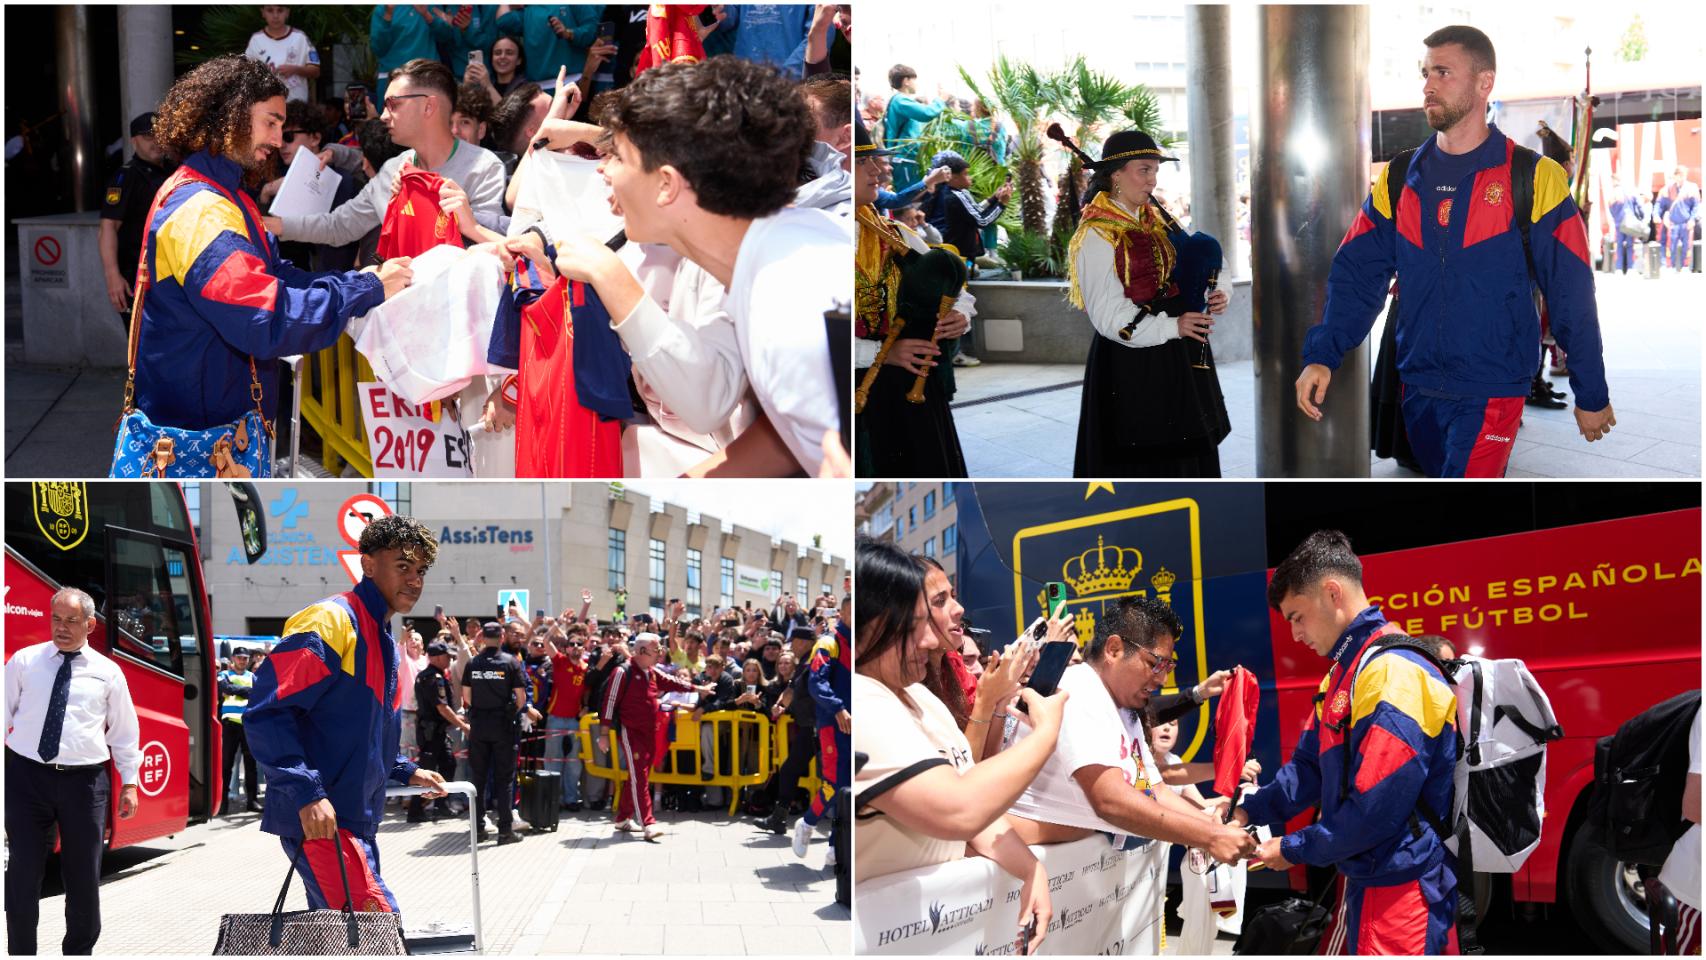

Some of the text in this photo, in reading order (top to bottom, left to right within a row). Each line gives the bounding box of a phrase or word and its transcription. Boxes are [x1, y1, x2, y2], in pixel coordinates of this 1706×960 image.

[374, 425, 435, 473] 2019
[440, 526, 533, 544] AssisTens
[1367, 557, 1702, 610] CCIÓN ESPAÑOLA
[4, 602, 27, 615] alcon
[1391, 602, 1588, 635] E FÚTBOL
[145, 754, 163, 768] RF
[144, 769, 163, 783] EF
[1048, 870, 1075, 887] TTICA21
[878, 898, 994, 946] HOTEL ATTICA21
